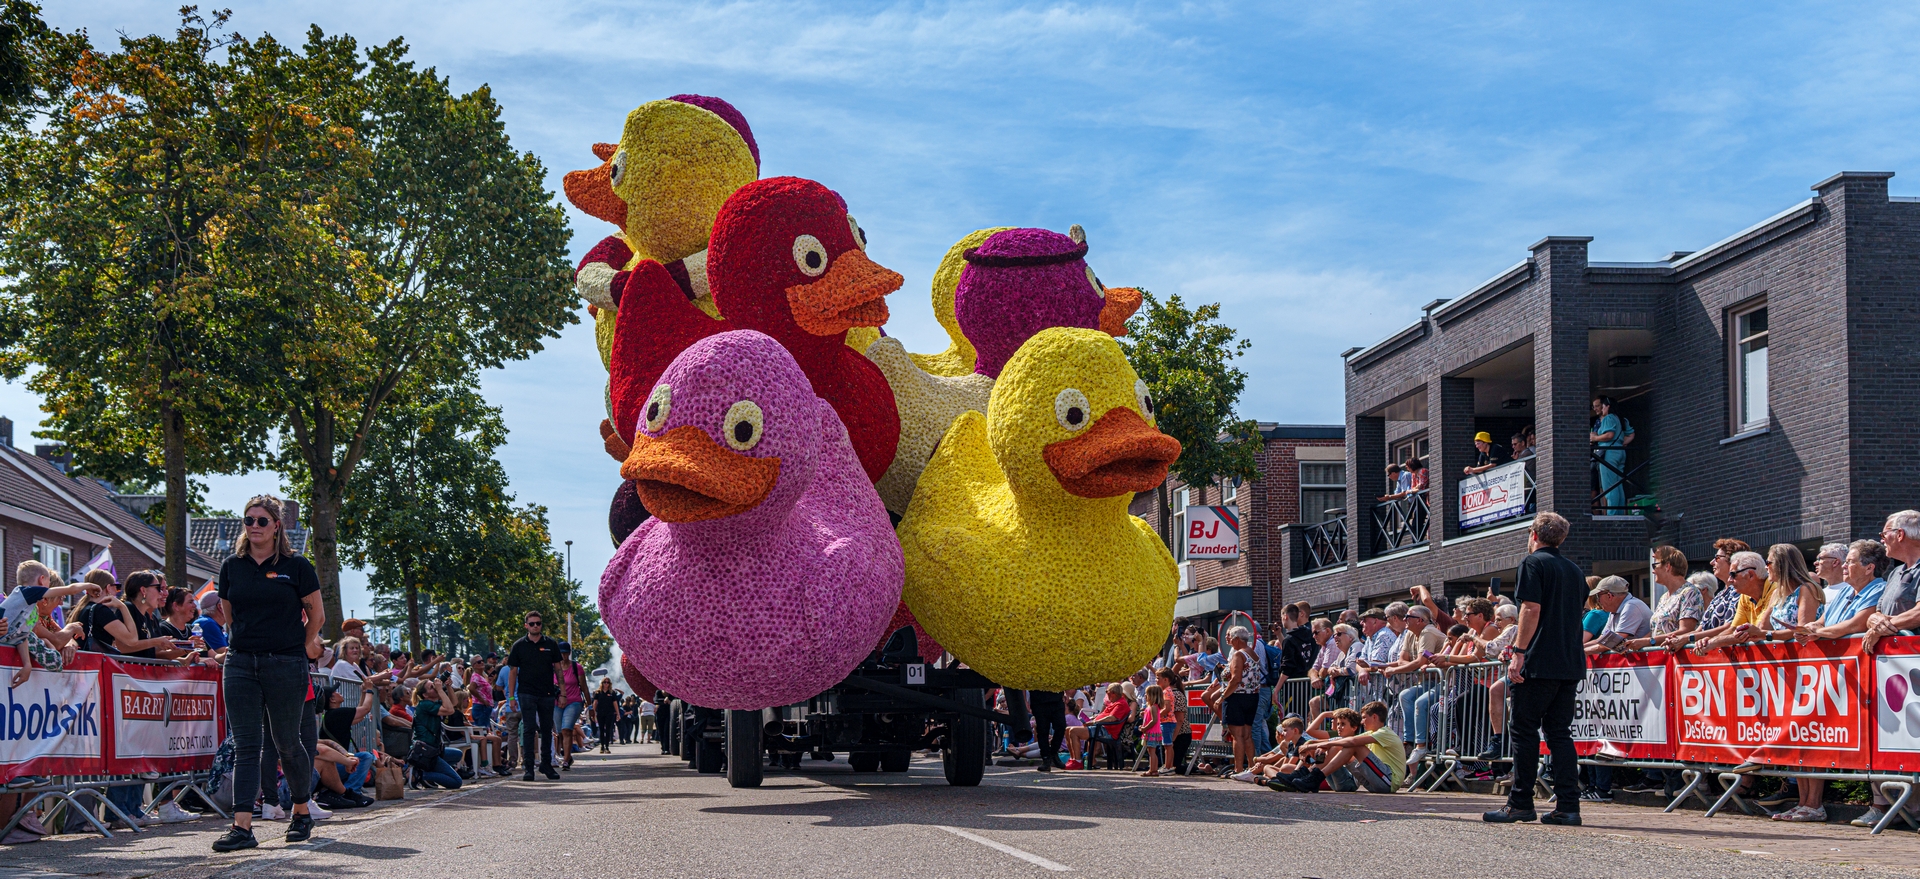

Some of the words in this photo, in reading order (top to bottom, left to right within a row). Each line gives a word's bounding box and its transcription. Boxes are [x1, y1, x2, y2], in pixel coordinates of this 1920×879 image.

[1463, 491, 1484, 509] JOKO
[1189, 520, 1220, 539] BJ
[1189, 544, 1238, 554] Zundert
[909, 666, 922, 678] 01
[1681, 669, 1727, 717] BN
[1736, 666, 1785, 717] BN
[1791, 663, 1849, 717] BN
[124, 695, 164, 716] BARRY
[172, 698, 213, 716] CALLEBAUT
[1574, 698, 1640, 720] BRABANT
[1571, 724, 1599, 738] EVOEL
[1619, 725, 1643, 739] HIER
[1684, 720, 1728, 741] DeStem
[1737, 721, 1782, 742] DeStem
[1789, 721, 1849, 743] DeStem
[168, 735, 213, 751] DECORATIONS
